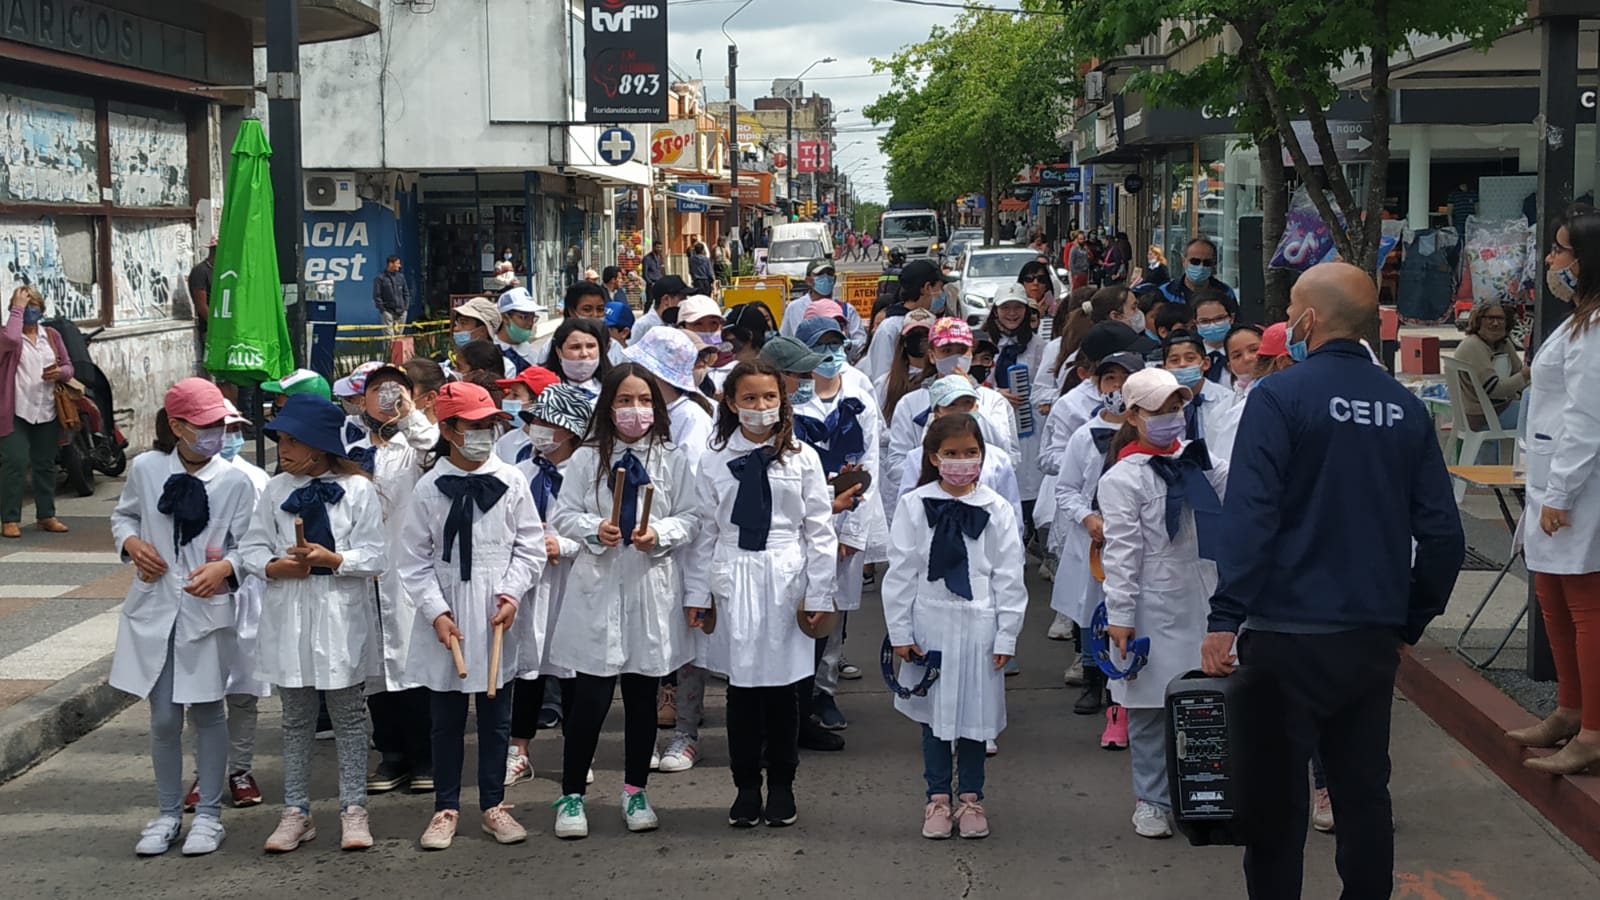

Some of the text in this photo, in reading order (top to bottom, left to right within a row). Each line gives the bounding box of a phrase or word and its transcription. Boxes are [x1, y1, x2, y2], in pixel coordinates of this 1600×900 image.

[618, 73, 660, 95] 89.3
[592, 106, 660, 115] floridanoticias.com.uy
[736, 124, 751, 132] RO
[736, 131, 761, 141] mpio
[651, 133, 694, 164] STOP!
[304, 253, 367, 281] est
[854, 288, 876, 297] ATEN
[227, 351, 264, 366] ALUS
[1329, 396, 1404, 427] CEIP
